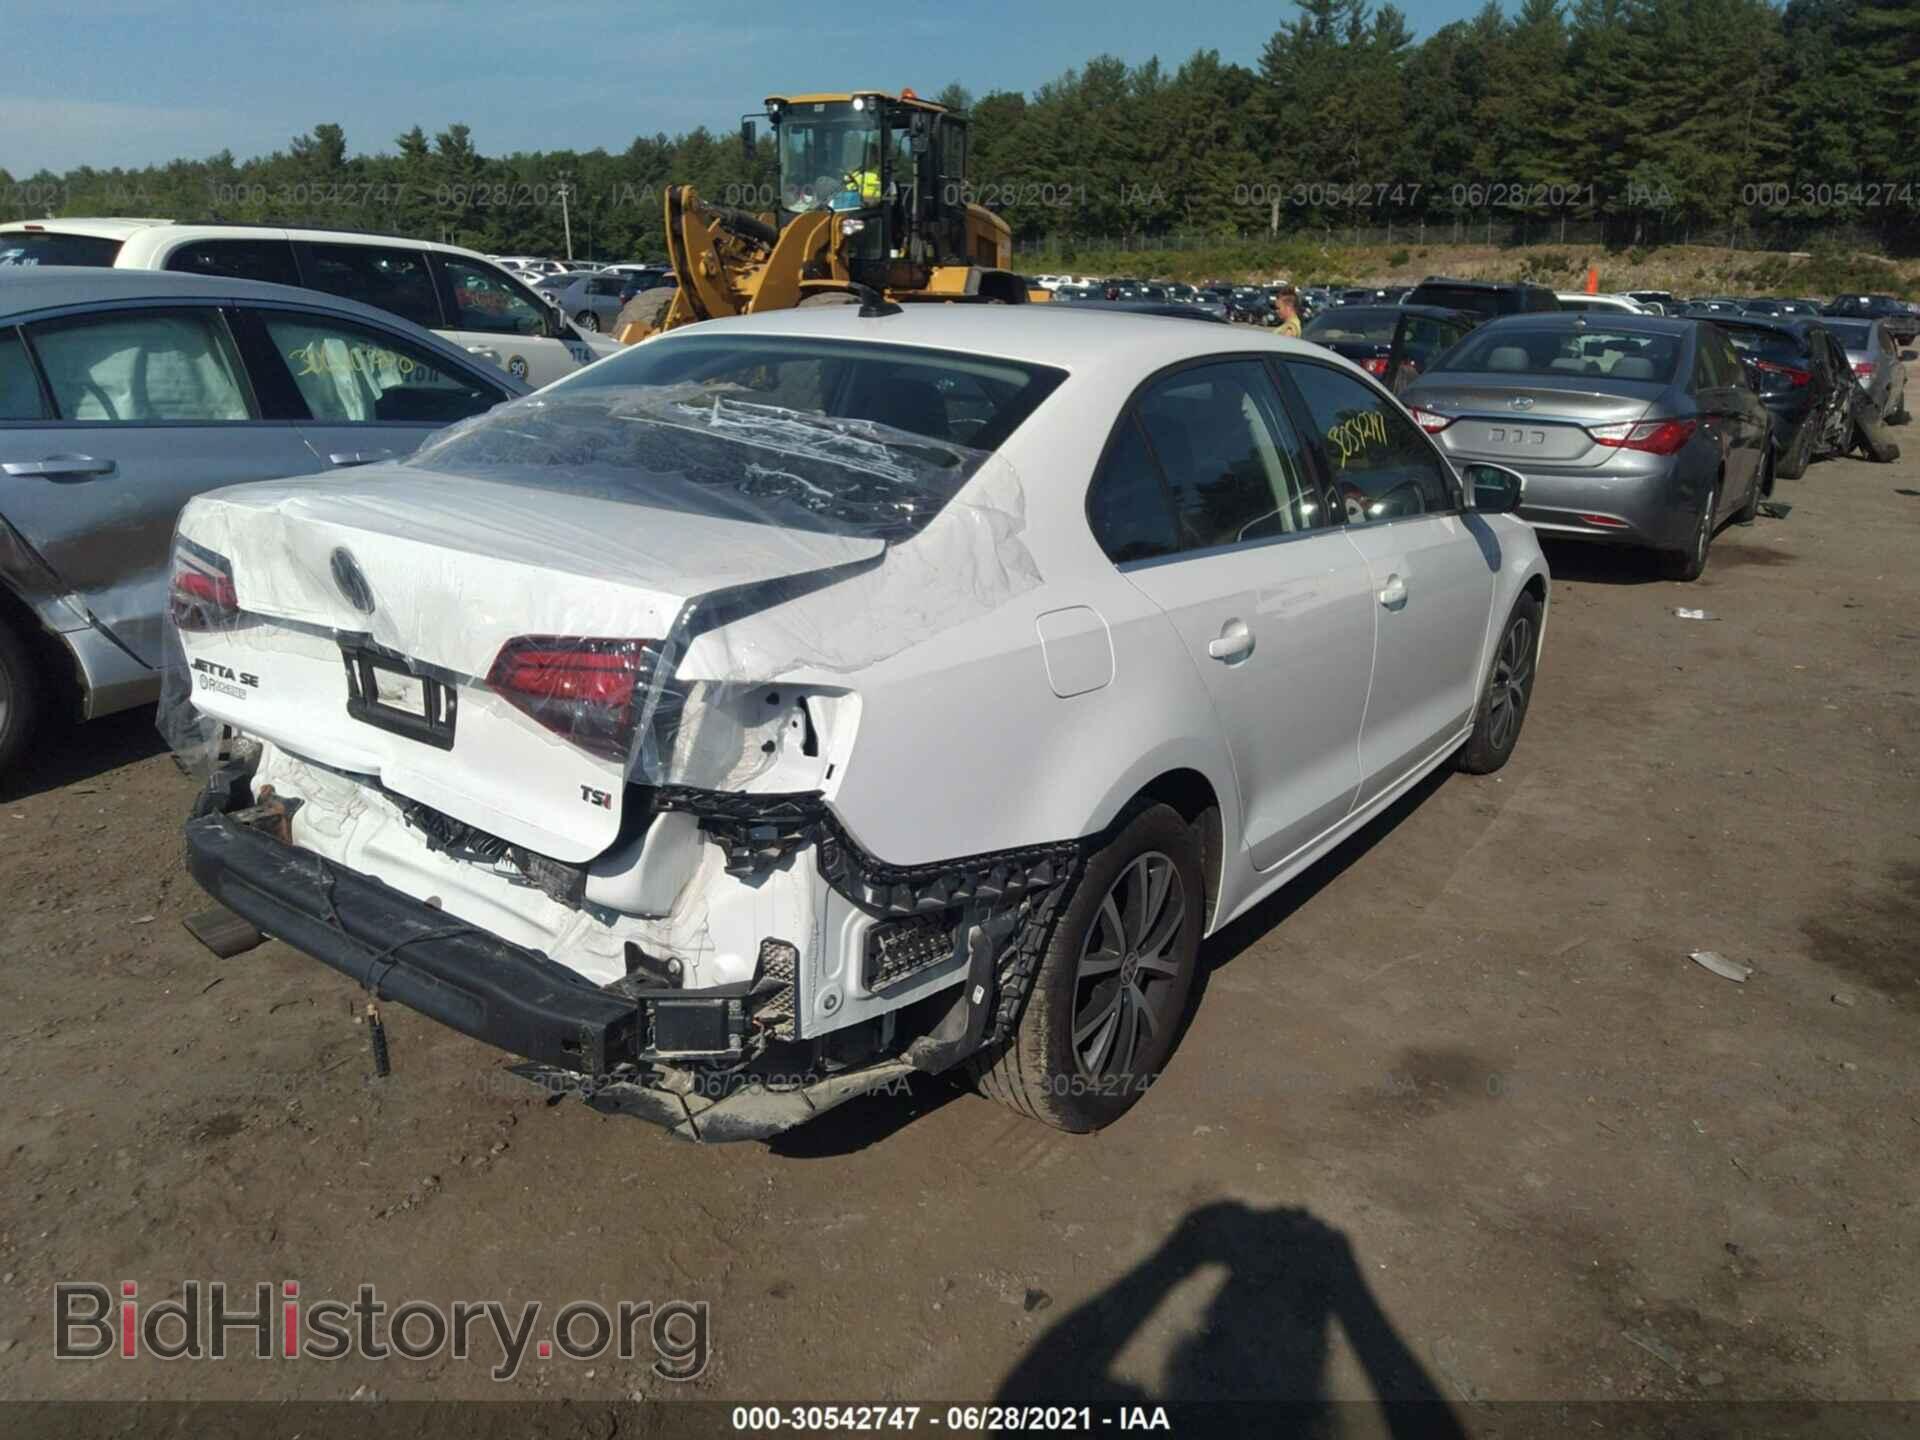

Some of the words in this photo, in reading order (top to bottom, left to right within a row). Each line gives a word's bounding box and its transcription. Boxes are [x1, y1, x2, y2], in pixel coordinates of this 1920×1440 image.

[511, 363, 525, 377] 90
[190, 657, 237, 681] JETTA
[239, 672, 260, 689] SE
[580, 784, 612, 810] TSI
